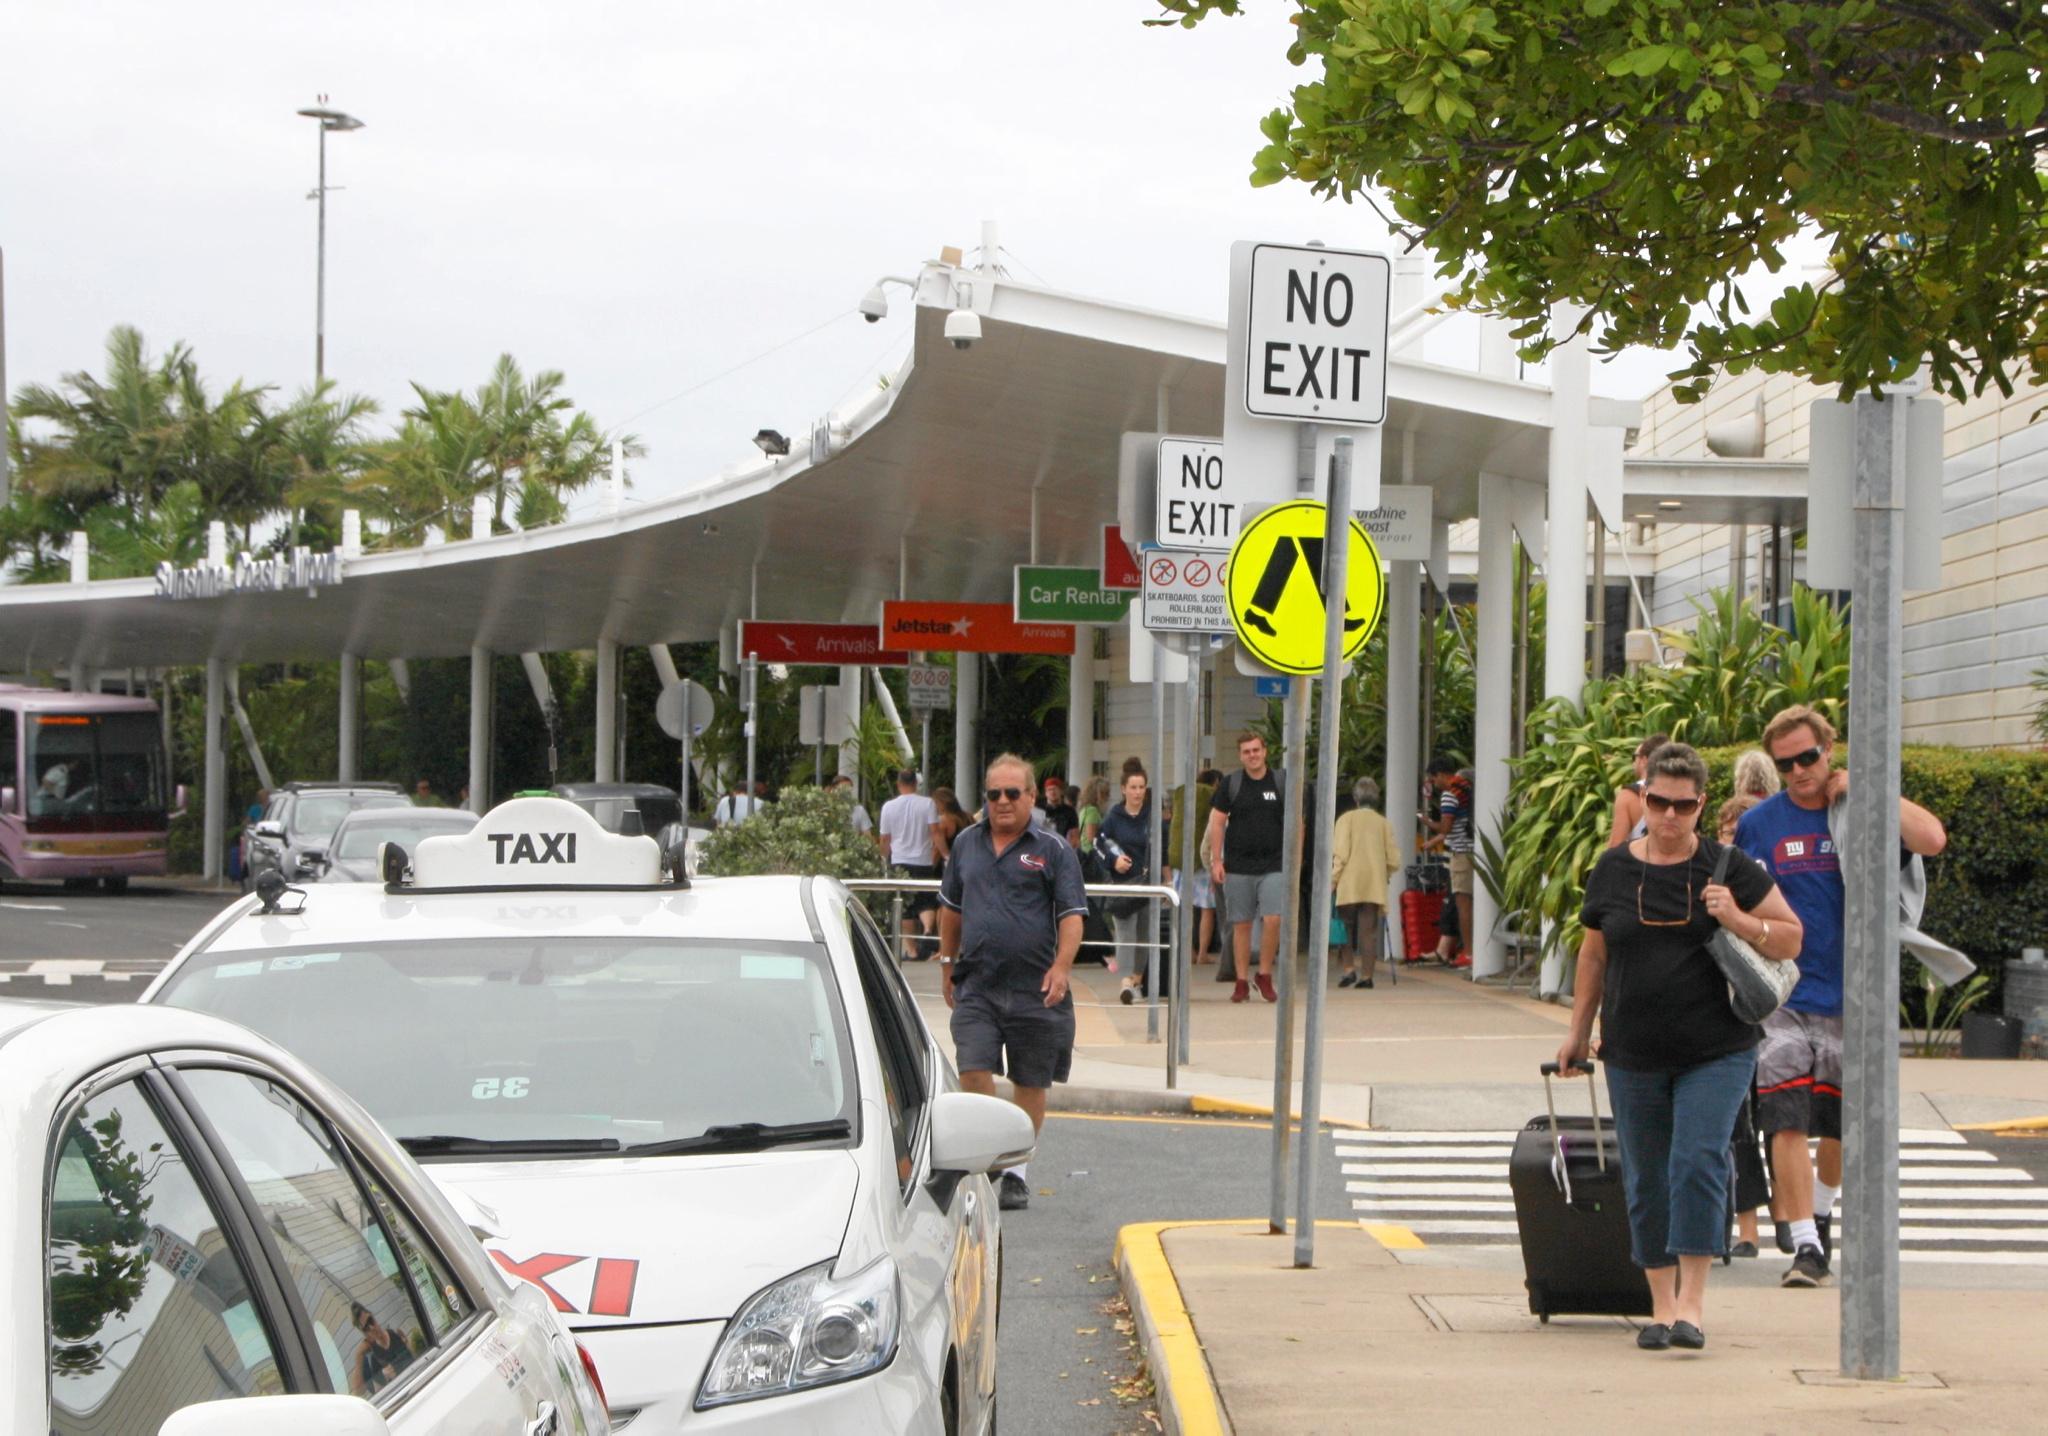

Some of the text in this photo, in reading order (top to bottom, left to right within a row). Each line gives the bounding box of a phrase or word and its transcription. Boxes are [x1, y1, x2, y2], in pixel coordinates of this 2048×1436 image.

[1286, 269, 1354, 328] NO
[1263, 341, 1371, 402] EXIT
[1181, 454, 1223, 491] NO
[1168, 499, 1235, 537] EXIT
[1356, 506, 1407, 520] unshine
[1372, 534, 1412, 543] IRPORT
[155, 545, 343, 599] Sunshine Coast Airport
[1030, 586, 1122, 605] Car Rental
[1201, 594, 1227, 604] SCOOT
[1169, 604, 1223, 615] ROLLERBLADES
[892, 618, 952, 635] Jetstar
[1151, 616, 1193, 625] PROHIBITED
[1194, 617, 1202, 625] IN
[1204, 617, 1219, 626] THIS
[1022, 627, 1068, 640] Arrivals
[816, 636, 876, 655] Arrivals
[487, 833, 577, 865] TAXI
[487, 1250, 640, 1317] XI
